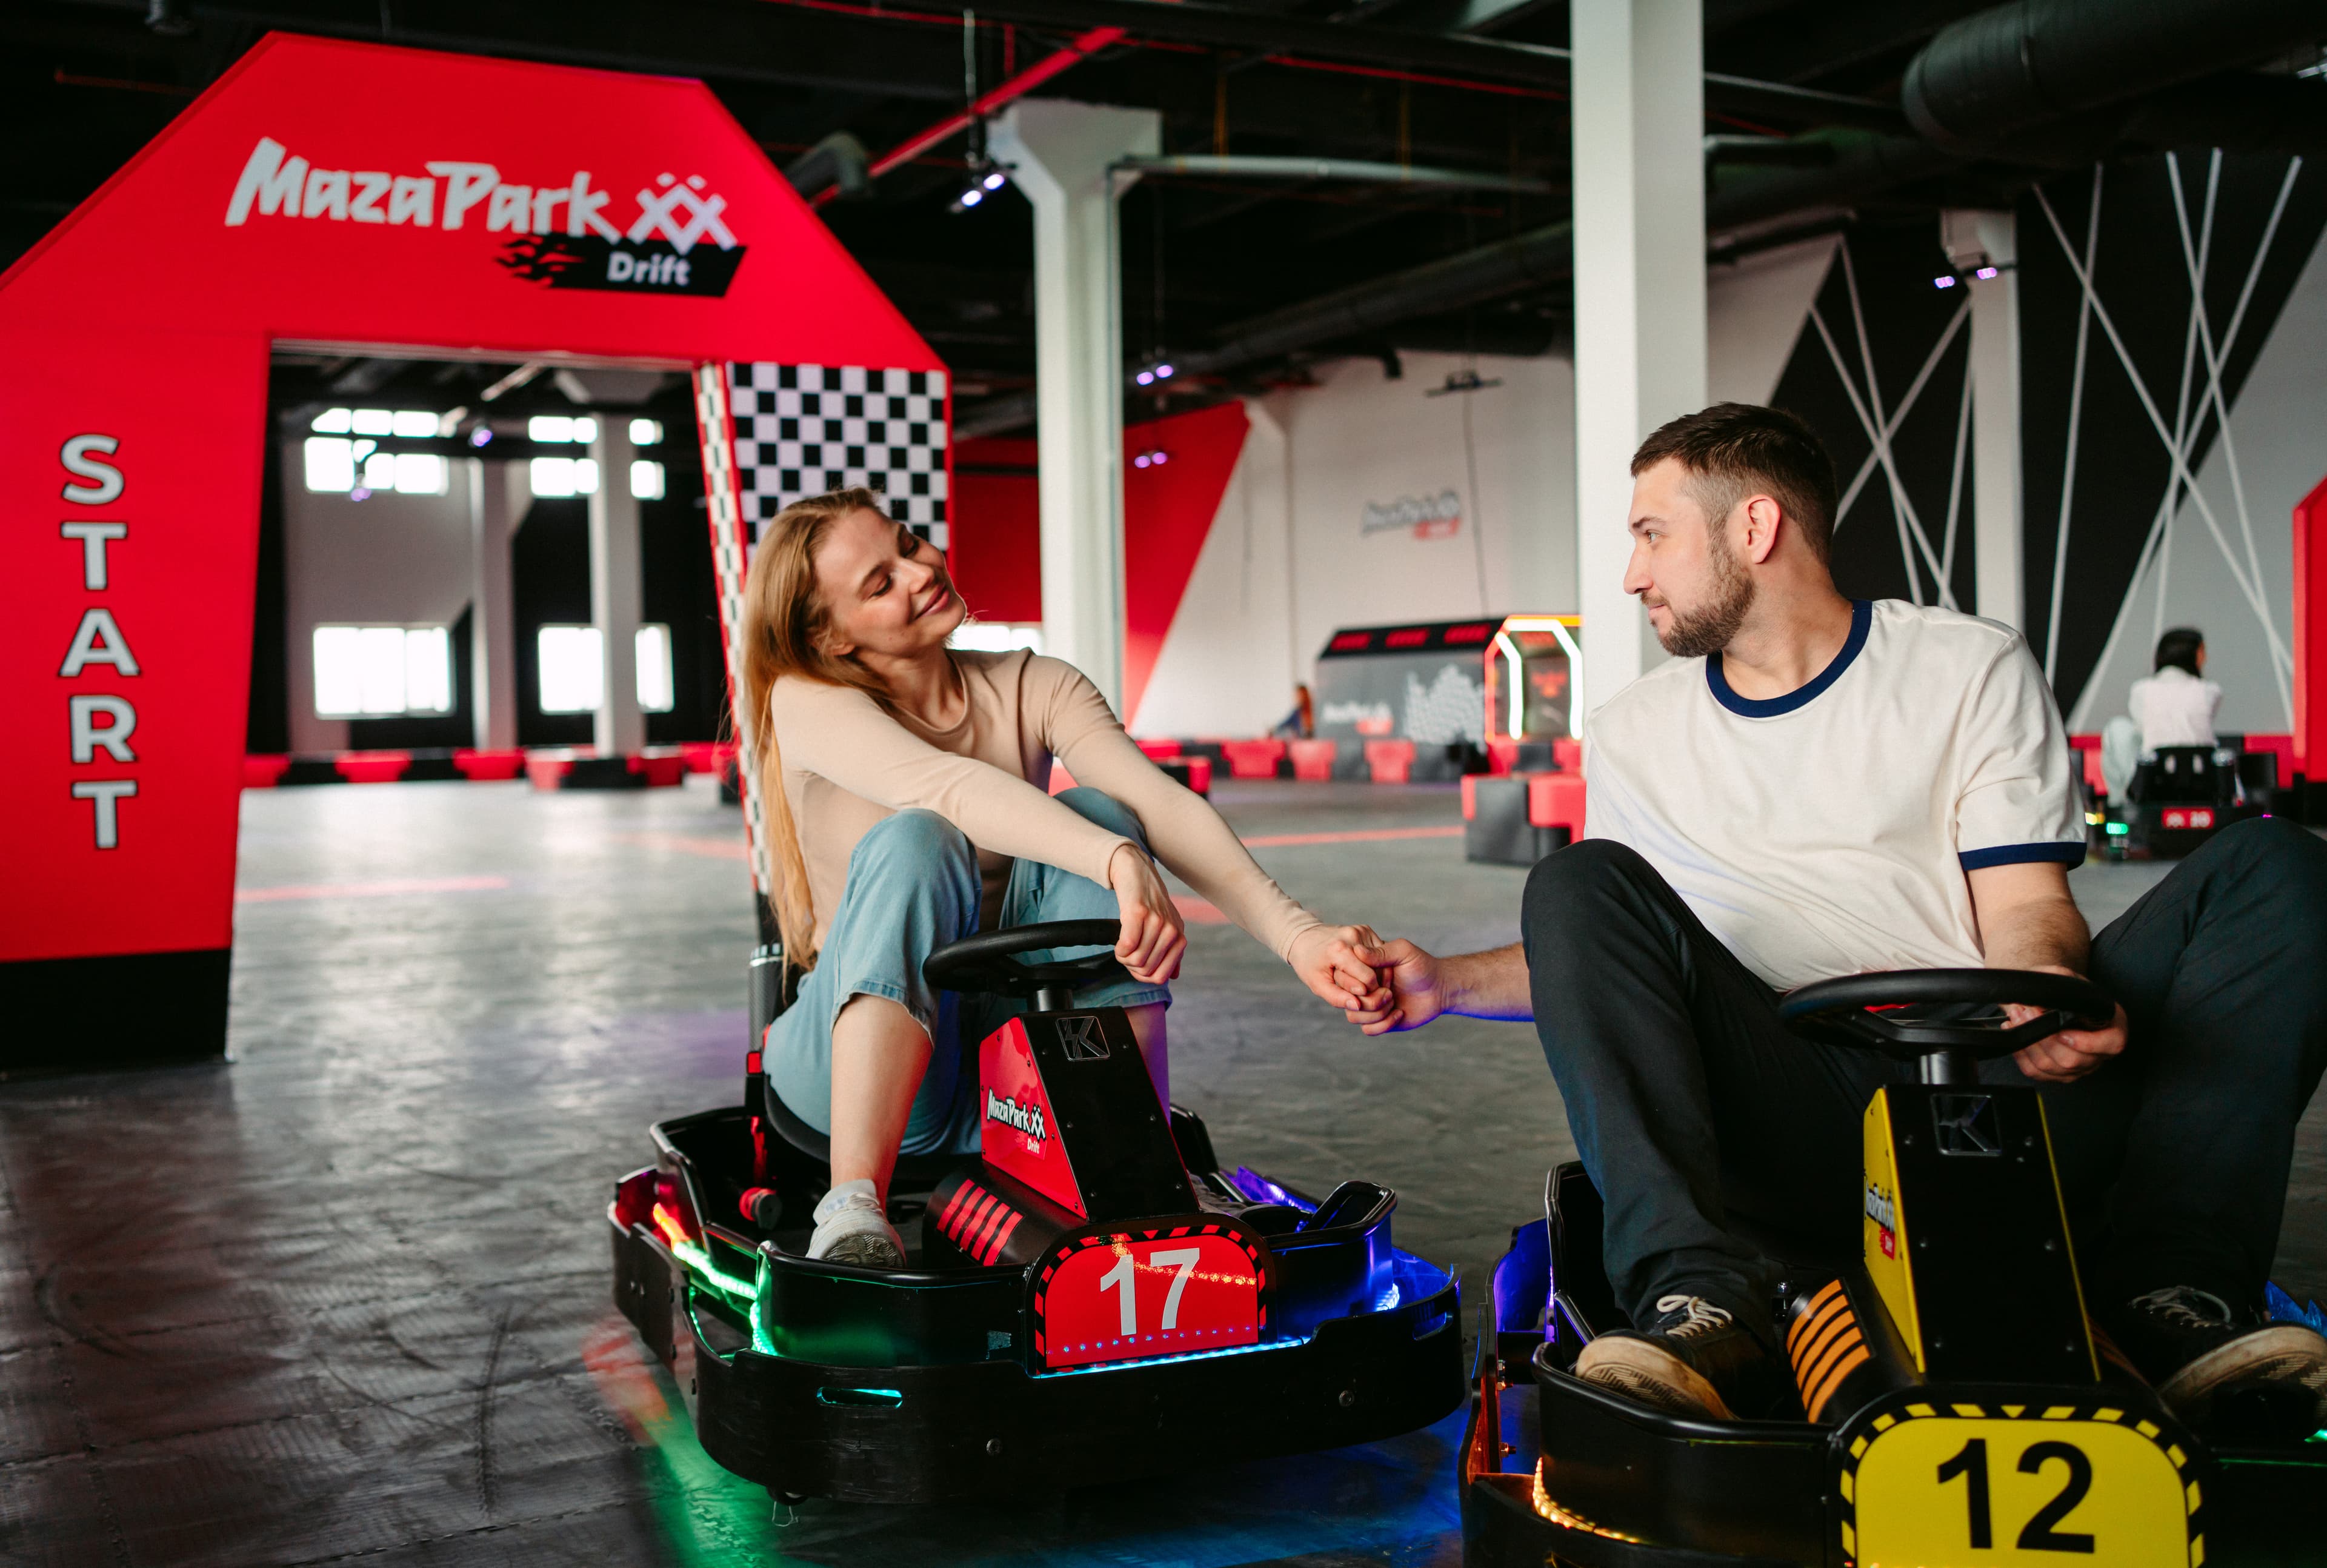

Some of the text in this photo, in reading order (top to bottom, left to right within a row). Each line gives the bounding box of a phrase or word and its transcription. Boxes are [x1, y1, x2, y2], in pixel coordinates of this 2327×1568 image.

[225, 136, 622, 245] MazaPark
[607, 251, 690, 286] Drift
[59, 434, 141, 849] START
[987, 1088, 1031, 1135] MazaPark
[1027, 1138, 1039, 1154] Drift
[1100, 1247, 1200, 1336] 17
[1937, 1438, 2096, 1553] 12
